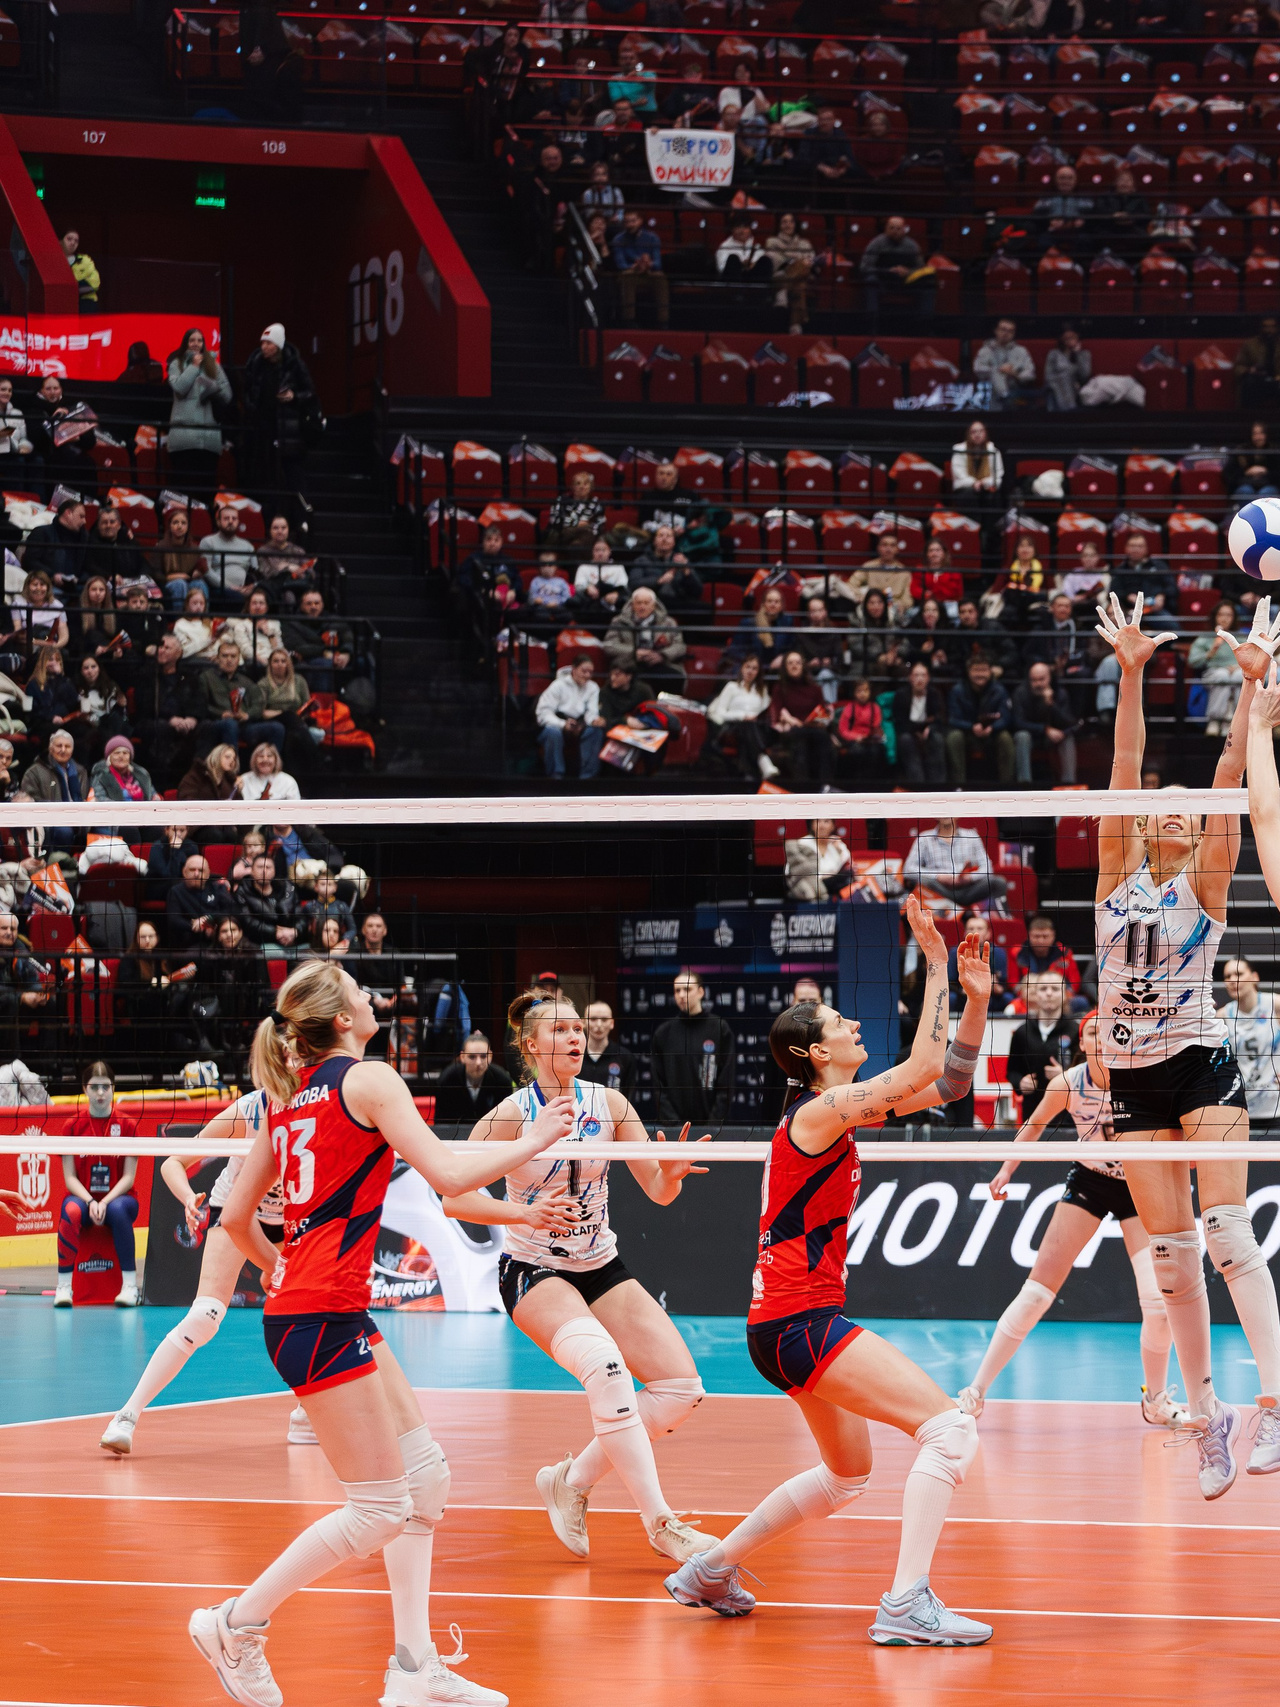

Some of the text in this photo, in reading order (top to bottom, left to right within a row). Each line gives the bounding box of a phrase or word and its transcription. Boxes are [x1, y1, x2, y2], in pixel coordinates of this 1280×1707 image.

[82, 130, 106, 144] 107
[261, 140, 286, 154] 108
[655, 164, 732, 184] ОМИЧКУ
[1124, 919, 1160, 970] 11
[1112, 1006, 1178, 1017] ФОСАГРО
